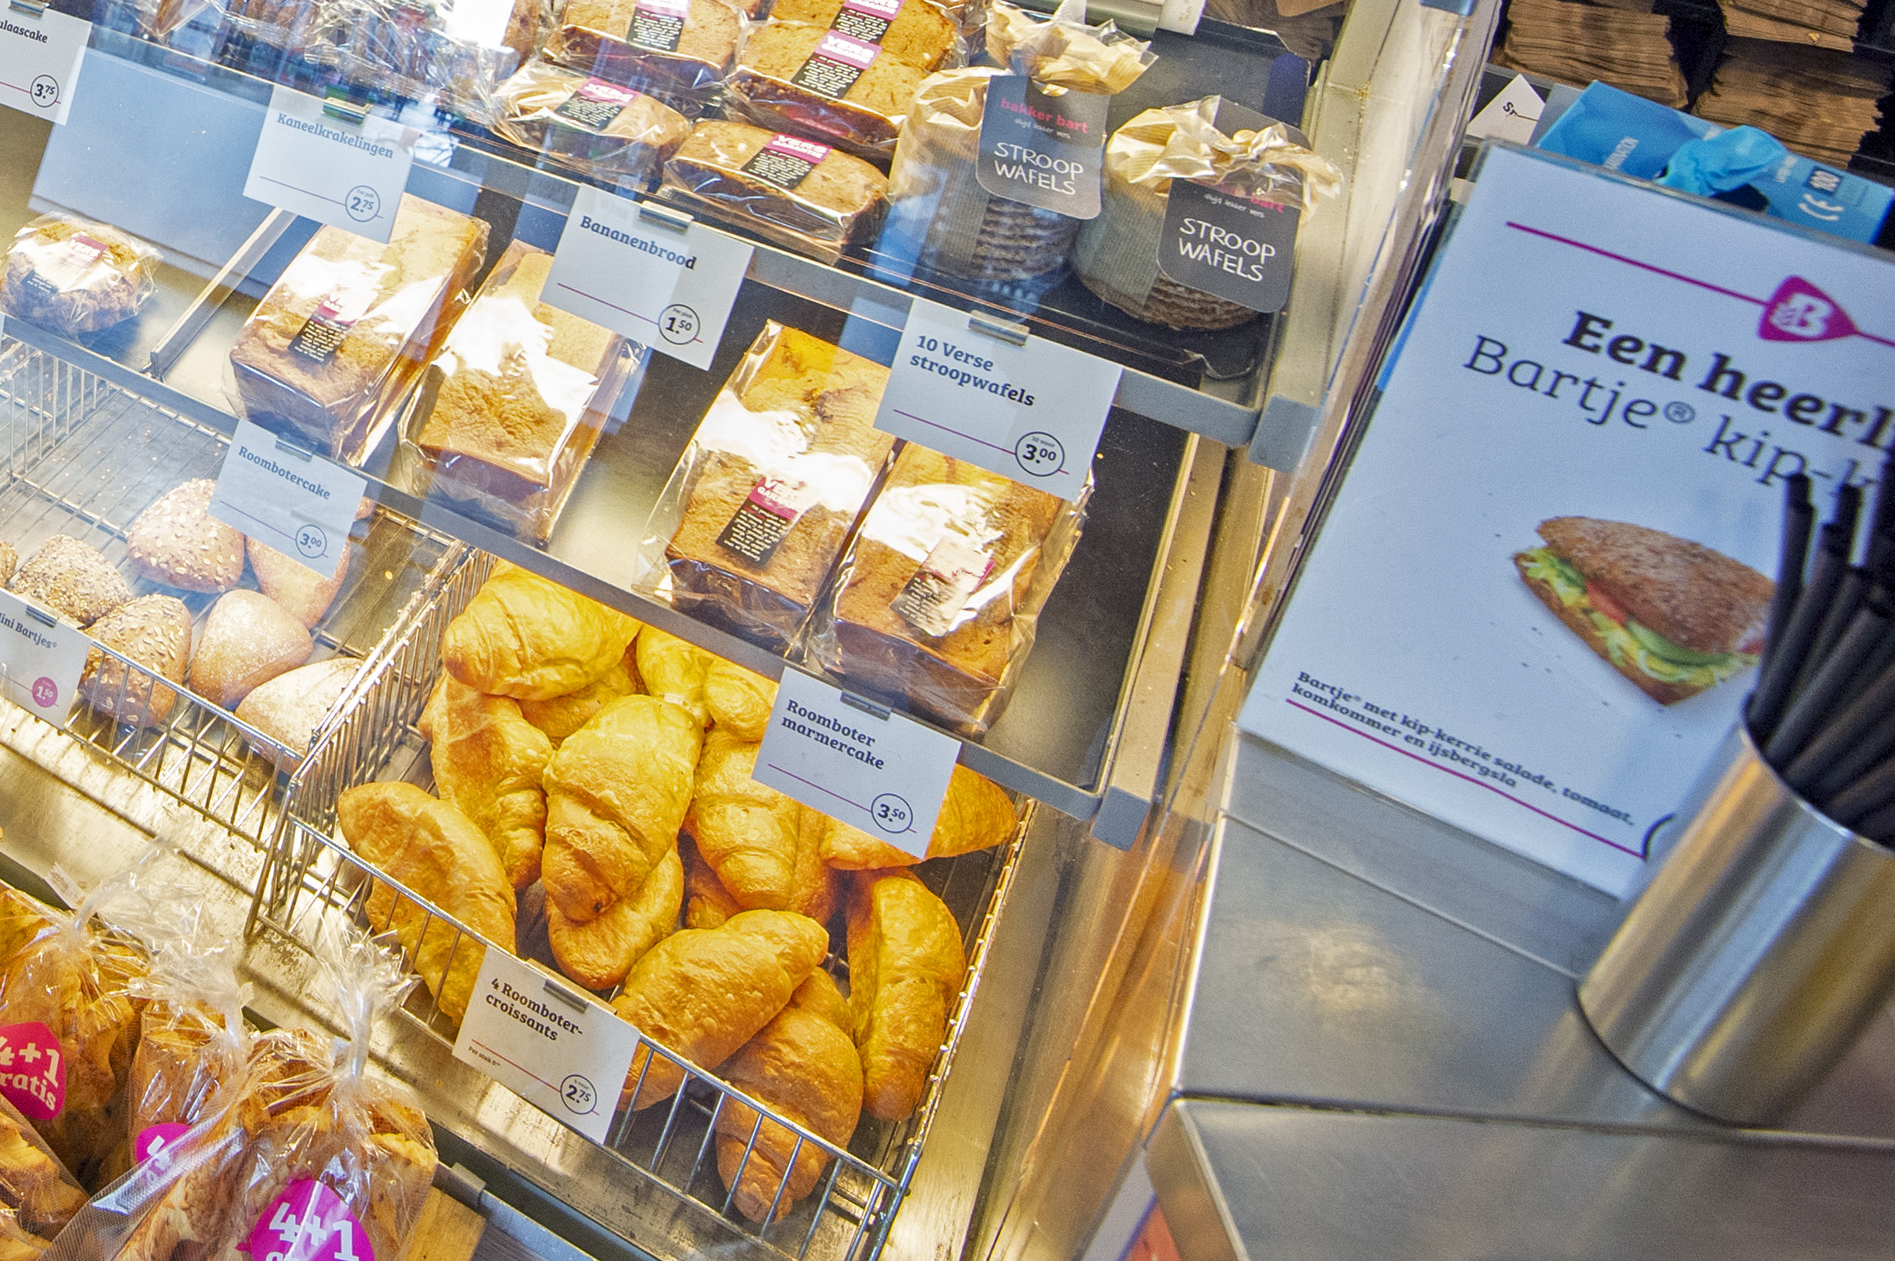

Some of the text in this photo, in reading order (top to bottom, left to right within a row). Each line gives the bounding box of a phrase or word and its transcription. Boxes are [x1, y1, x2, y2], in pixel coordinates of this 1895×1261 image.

[827, 35, 877, 59] VERS
[34, 83, 56, 100] 3.75
[276, 112, 394, 159] Kaneelkrakelingen
[1000, 98, 1089, 134] bakker bart
[771, 139, 824, 159] GARANTIE
[776, 134, 828, 154] VERS
[994, 141, 1084, 181] STROOP
[994, 159, 1076, 196] WAFELS
[350, 196, 375, 213] 2.75
[579, 215, 698, 270] Bananenbrood
[1179, 217, 1276, 262] STROOP
[1179, 237, 1264, 282] WAFELS
[665, 316, 693, 335] 1.50
[916, 335, 994, 372] 10 Verse
[909, 354, 1036, 407] stroopwafels
[1561, 309, 1895, 453] Een heerl
[238, 445, 331, 500] Roombotercake
[1022, 443, 1057, 465] 3.00
[1702, 414, 1879, 497] kip-k
[299, 533, 322, 549] 3.00
[35, 685, 54, 700] 1.50
[780, 716, 885, 770] marmercake
[786, 699, 876, 747] Roomboter
[1291, 683, 1517, 788] komkommer en ijsbergsla
[1364, 700, 1397, 722] met
[1400, 714, 1491, 762] kip-kerrie
[1493, 755, 1558, 794] salade,
[1562, 787, 1635, 826] tomaat,
[877, 803, 906, 822] 3.50
[485, 992, 559, 1042] croissants
[491, 977, 584, 1036] 4 Roomboter-
[467, 1045, 478, 1055] Per
[478, 1051, 492, 1064] stuk
[565, 1084, 591, 1104] 2.75
[268, 1201, 360, 1261] 4+1
